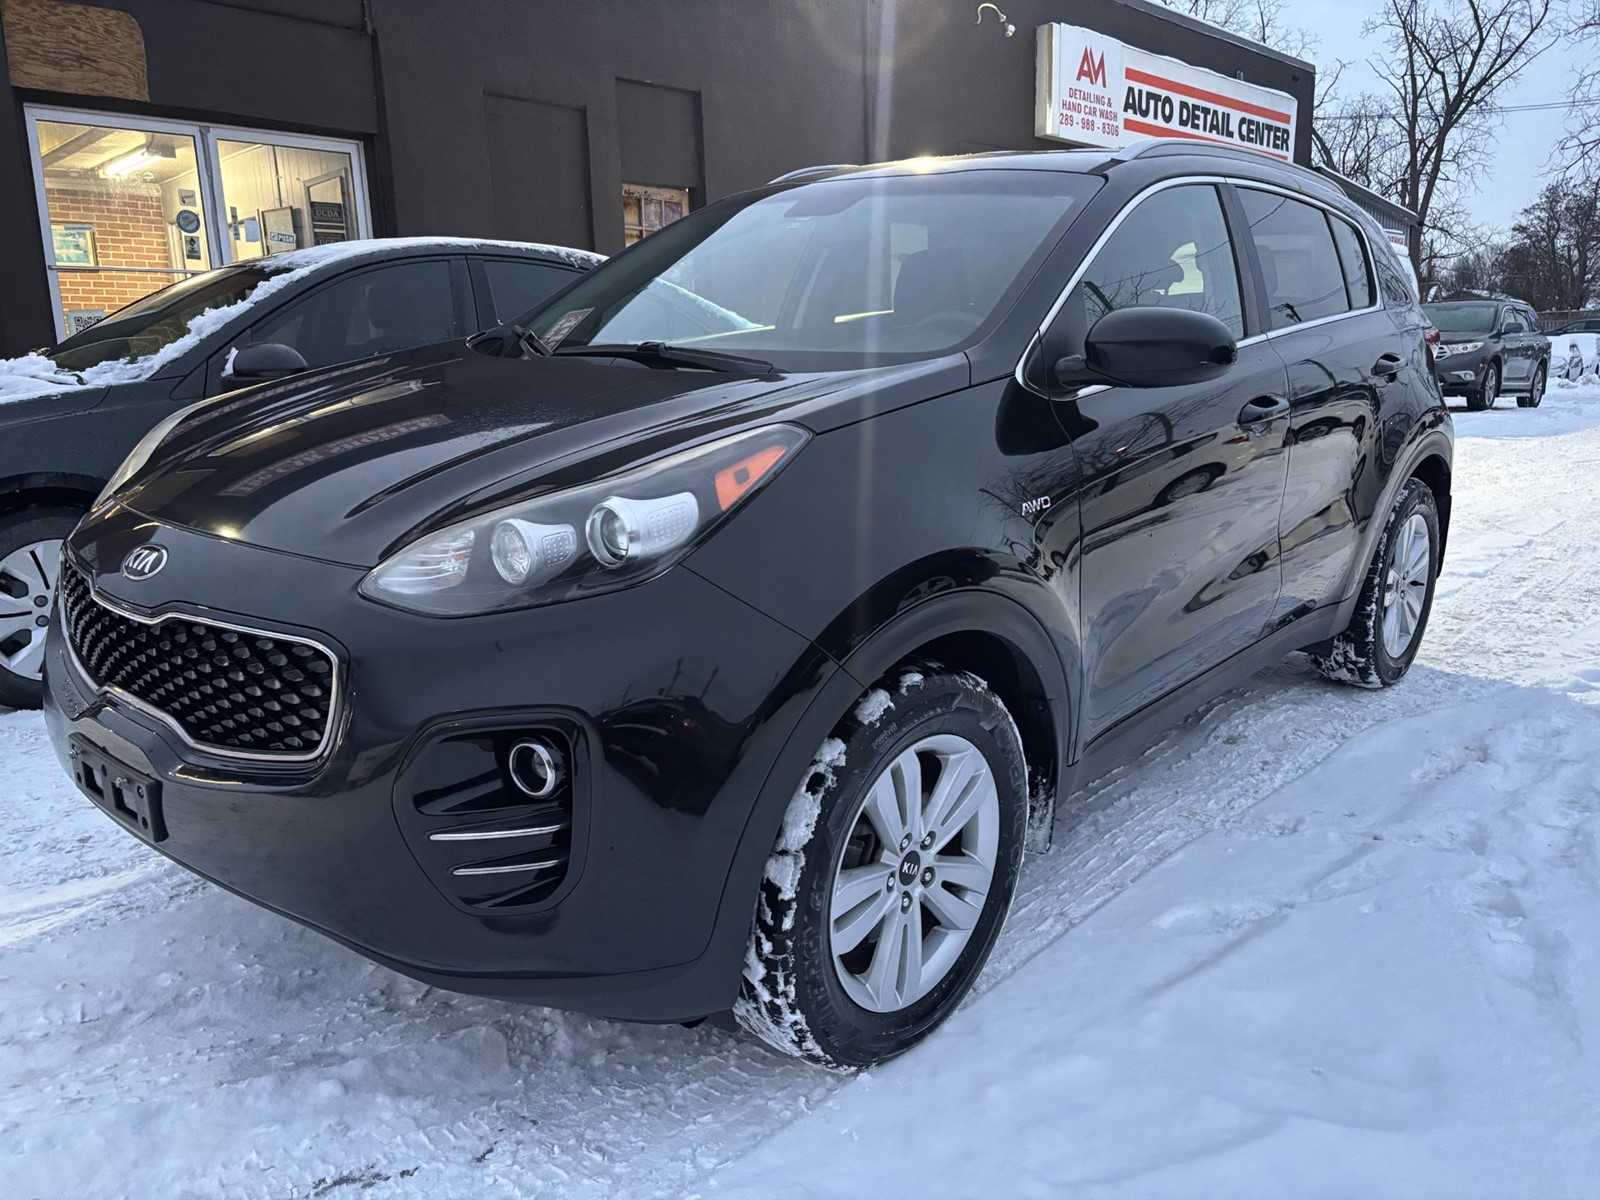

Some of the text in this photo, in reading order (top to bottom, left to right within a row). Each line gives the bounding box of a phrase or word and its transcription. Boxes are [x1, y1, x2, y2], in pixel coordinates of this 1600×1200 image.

[1076, 45, 1107, 88] AM
[1069, 87, 1113, 108] DETAILING &
[1062, 99, 1118, 122] HAND CAR WASH
[1123, 86, 1290, 152] AUTO DETAIL CENTER
[1060, 112, 1074, 127] 289
[1081, 117, 1095, 131] 988
[1102, 123, 1119, 137] 8306
[316, 208, 340, 219] UCDA
[1022, 495, 1051, 516] AWD
[902, 861, 919, 876] KIA
